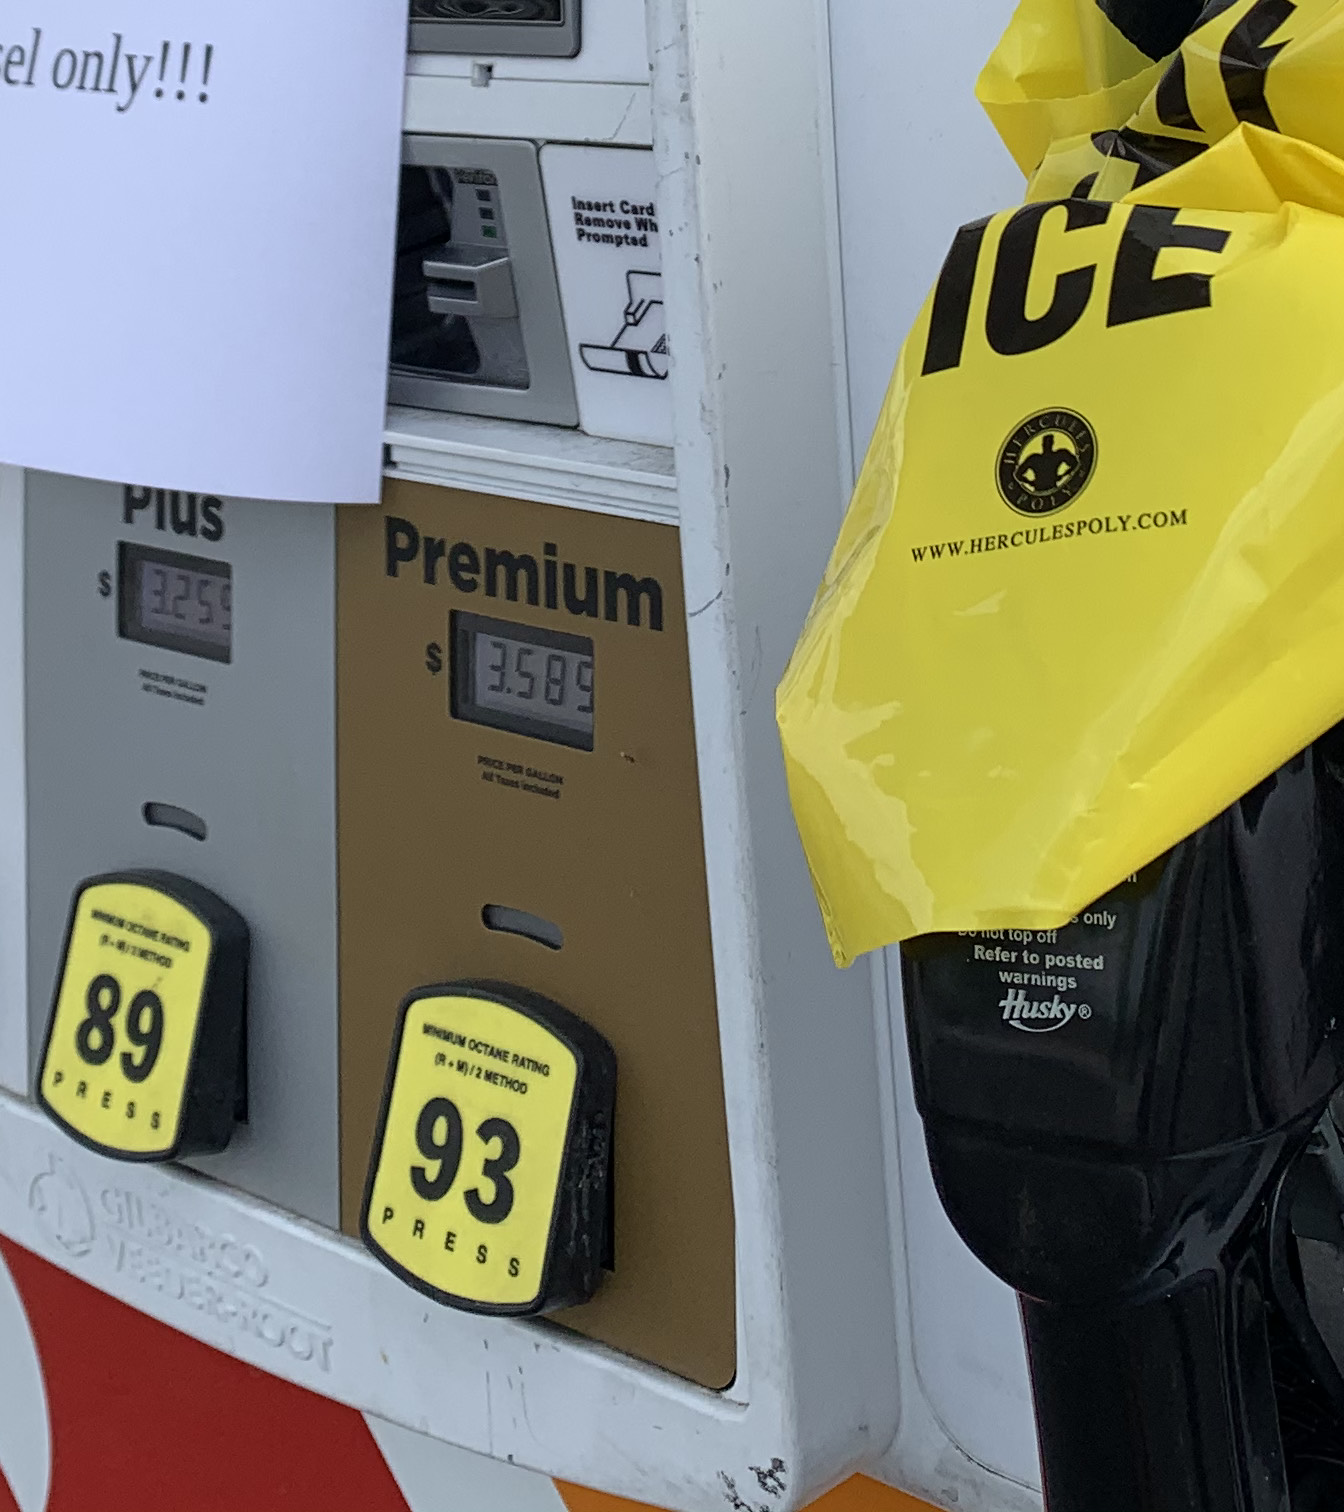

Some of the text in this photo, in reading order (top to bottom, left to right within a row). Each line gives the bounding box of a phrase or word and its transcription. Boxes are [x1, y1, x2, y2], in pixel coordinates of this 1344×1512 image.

[52, 33, 214, 113] only!!!
[571, 196, 655, 216] Insert Card
[573, 212, 632, 230] Remove
[576, 228, 649, 248] Prompted
[911, 509, 1189, 563] WWW.HERCULESPOLY.COM
[384, 515, 663, 632] Premium
[425, 641, 443, 675] $
[1083, 910, 1117, 930] only
[974, 944, 1105, 970] Refer to posted
[998, 970, 1078, 992] warnings
[75, 973, 165, 1084] 89
[422, 1023, 551, 1078] MINIMUM OCTANE RATING
[53, 1070, 161, 1130] PRESS
[484, 1068, 529, 1095] METHOD
[410, 1097, 521, 1225] 93
[382, 1207, 520, 1278] PRESS
